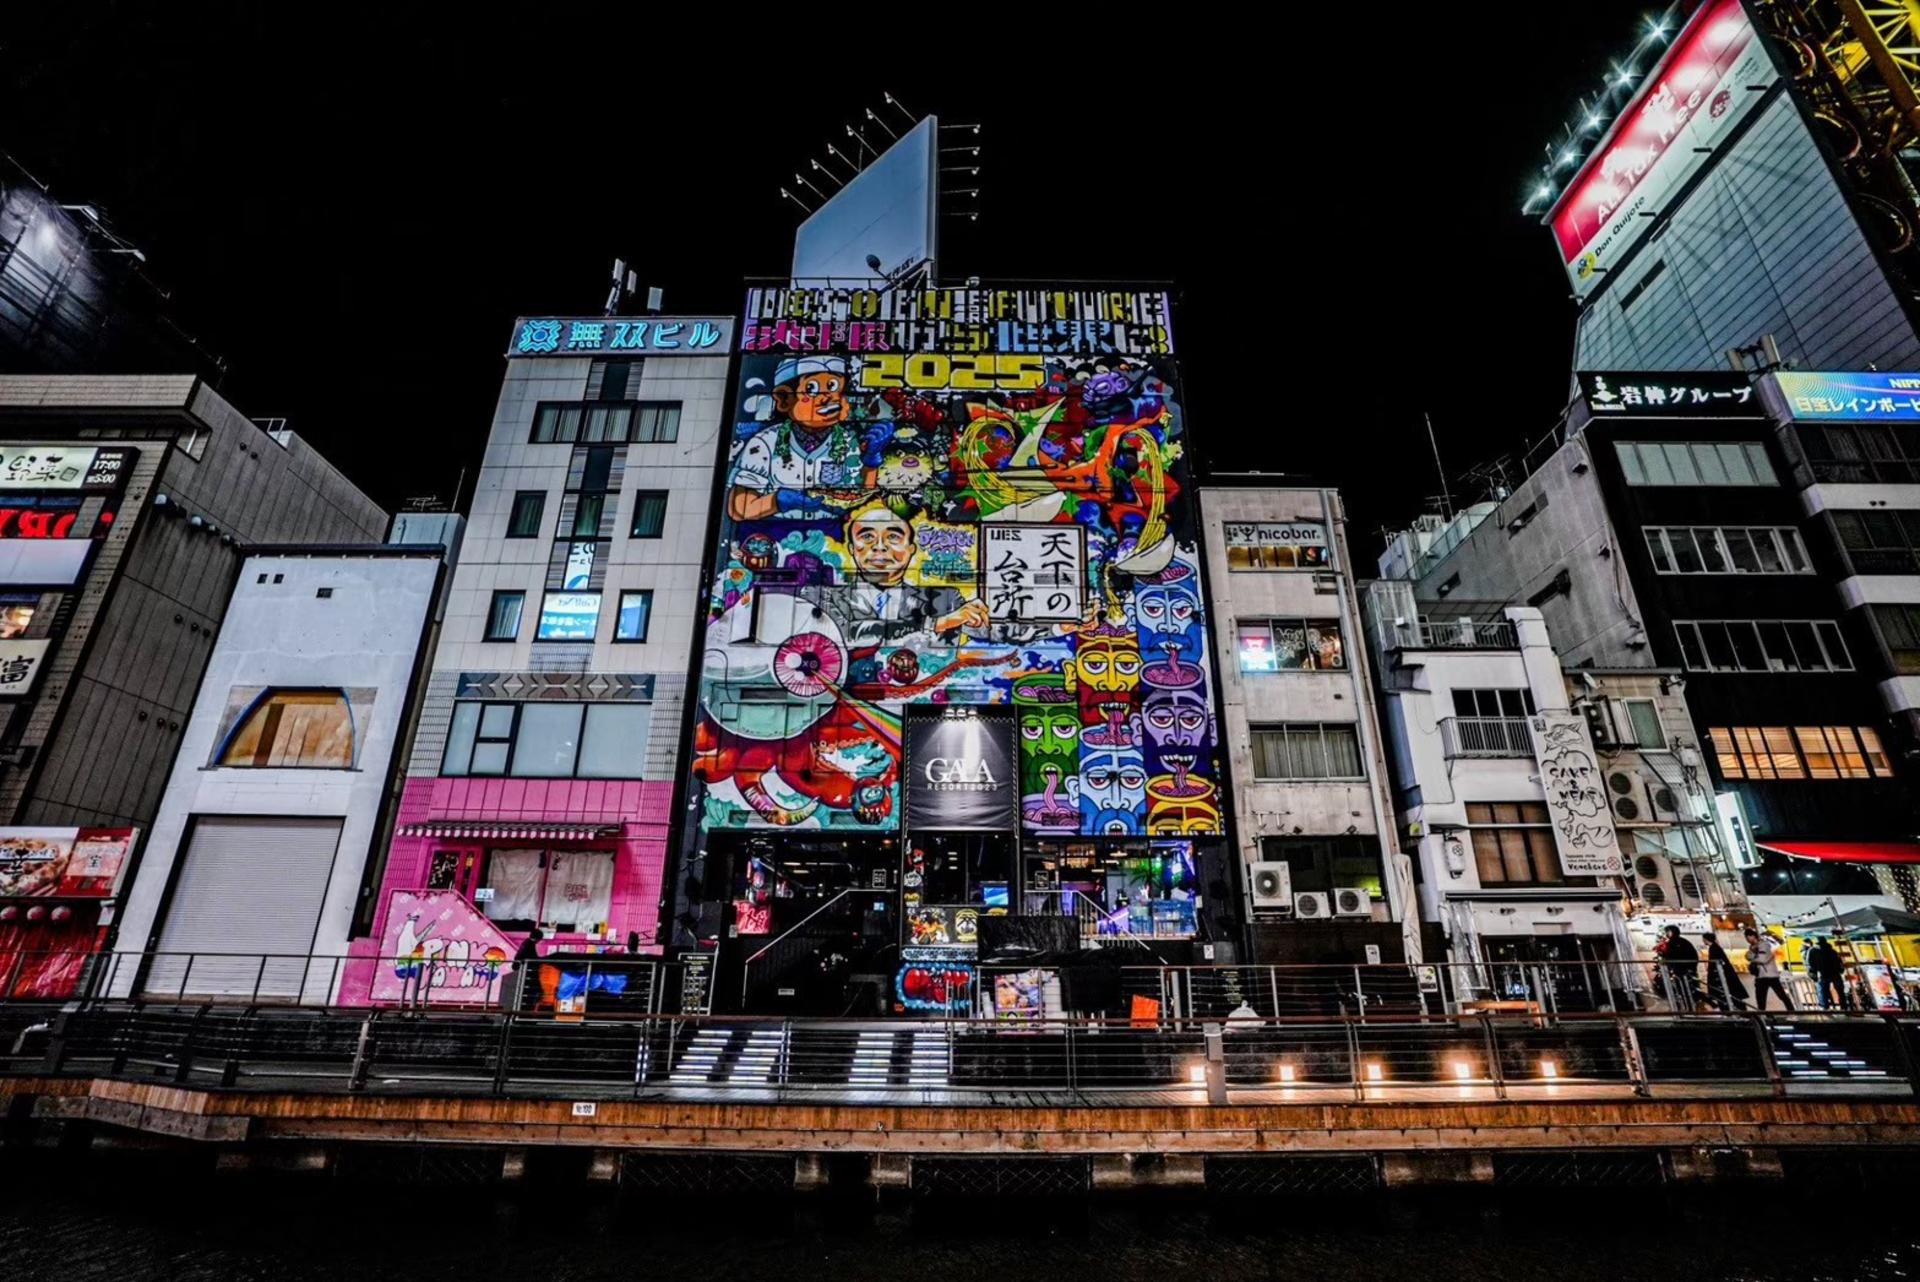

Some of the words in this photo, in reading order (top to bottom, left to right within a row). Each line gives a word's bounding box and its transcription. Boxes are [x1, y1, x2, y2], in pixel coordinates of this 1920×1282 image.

[1594, 235, 1612, 257] Don
[1612, 196, 1645, 236] Quijote
[569, 321, 721, 349] 無双ビル
[862, 354, 1046, 389] 2025
[93, 460, 121, 470] 17:00
[1258, 527, 1317, 541] nicobar
[992, 550, 1034, 617] 台所
[1040, 532, 1076, 614] 天下の
[925, 757, 997, 782] GALA
